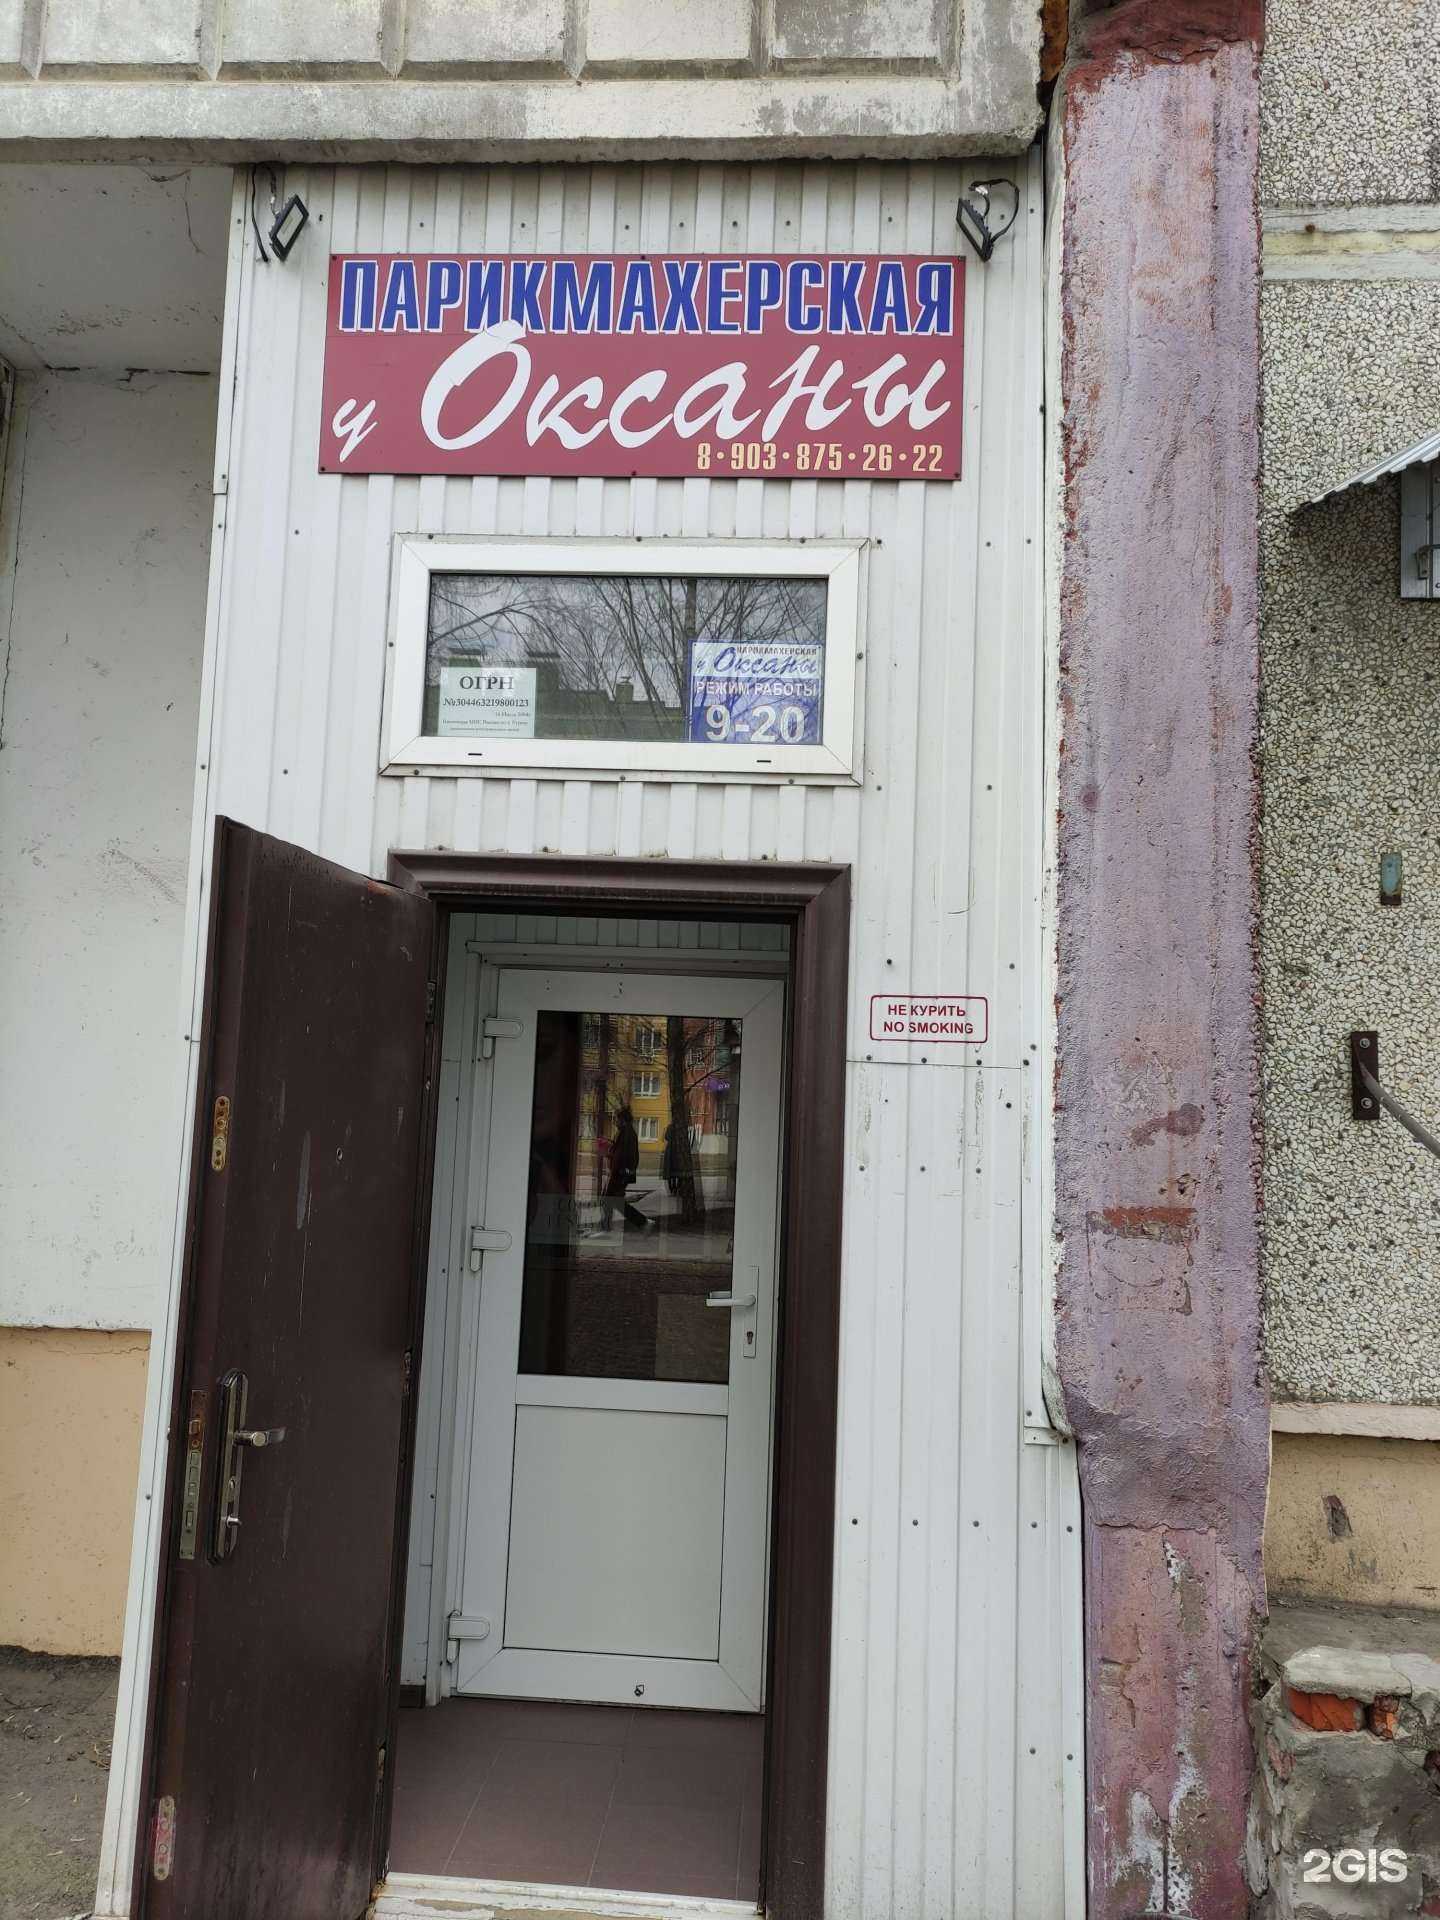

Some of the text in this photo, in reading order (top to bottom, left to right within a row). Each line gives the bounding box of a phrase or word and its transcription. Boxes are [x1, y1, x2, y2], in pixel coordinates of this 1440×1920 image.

[338, 259, 955, 337] ПАРИКМАХЕРСКАЯ
[331, 318, 952, 463] у Оксаны
[459, 676, 515, 690] ОГРН
[696, 681, 817, 697] РЕЖИМ РАБОТЫ
[706, 704, 805, 743] 9-20
[888, 1004, 966, 1017] НЕ КУРИТЬ
[883, 1021, 974, 1034] NO SMOKING
